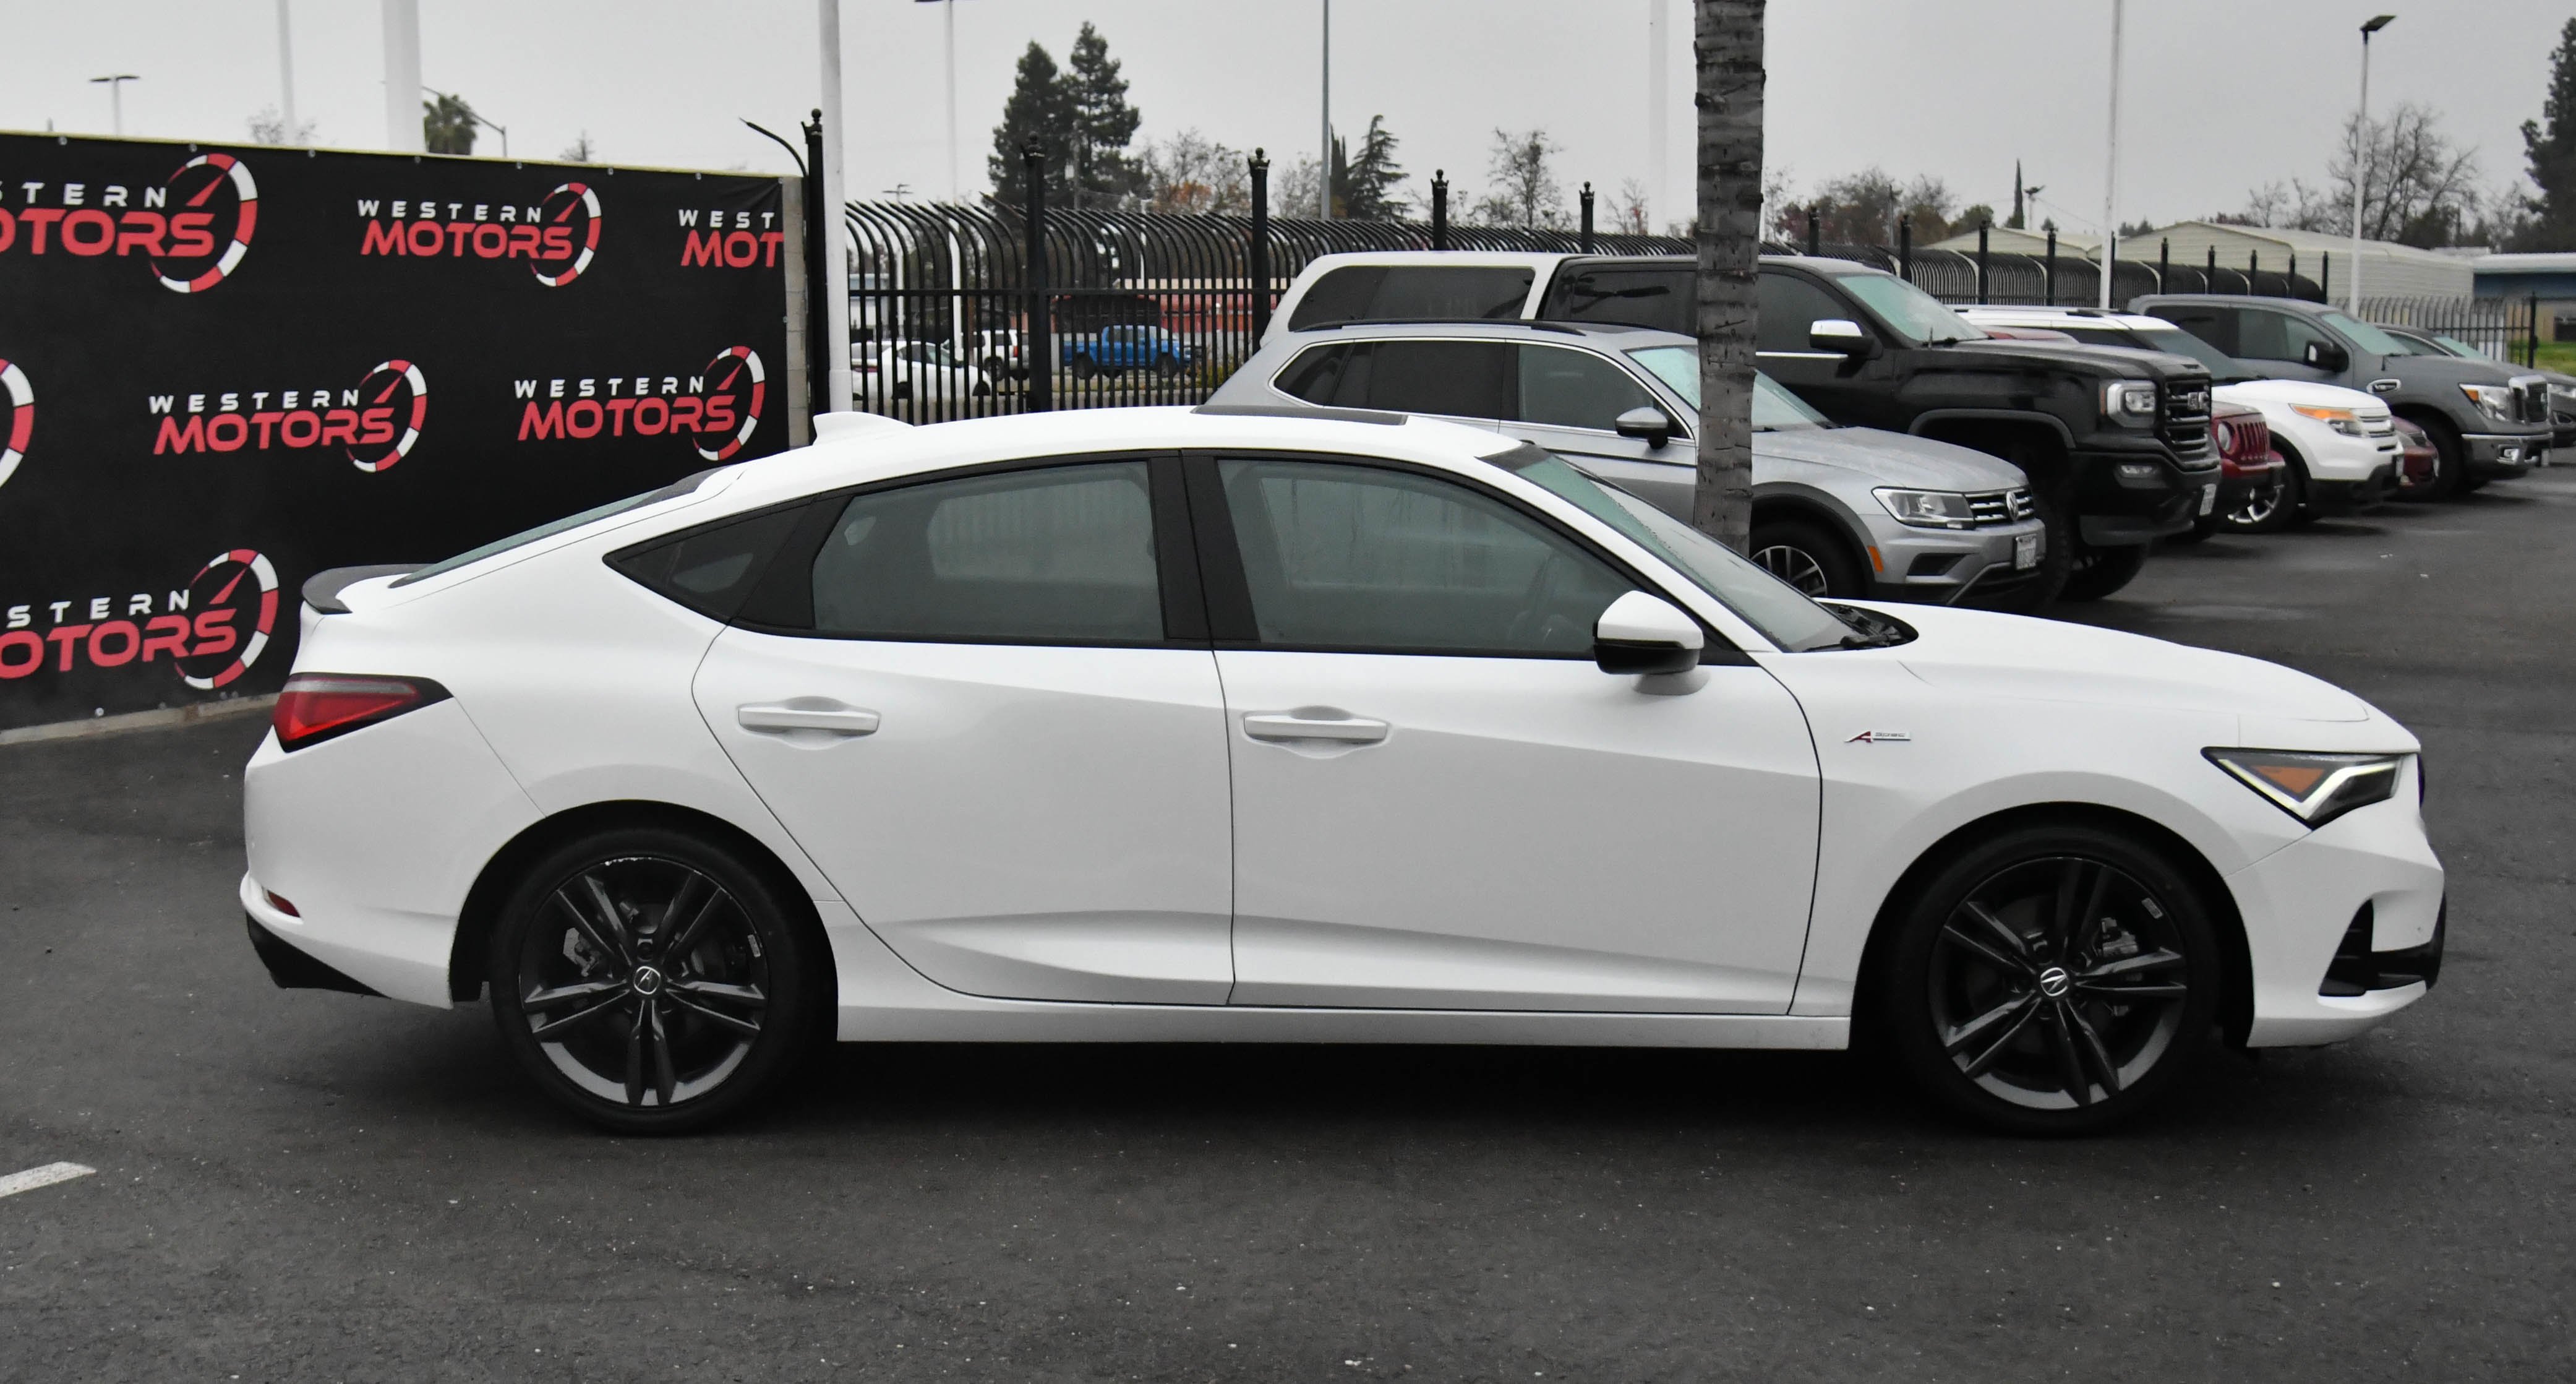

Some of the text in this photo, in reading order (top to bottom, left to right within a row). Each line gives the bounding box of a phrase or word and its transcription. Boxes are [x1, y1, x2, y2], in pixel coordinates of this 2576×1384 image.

[0, 180, 166, 208] TERN
[357, 199, 541, 223] WESTERN
[0, 207, 215, 257] TORS
[678, 209, 774, 229] WEST
[361, 219, 573, 260] MOTORS
[680, 230, 784, 268] MOT
[149, 389, 359, 414] WESTERN
[515, 376, 704, 398] WESTERN
[153, 407, 394, 455] MOTORS
[518, 395, 736, 441] MOTORS
[7, 589, 189, 628] STERN
